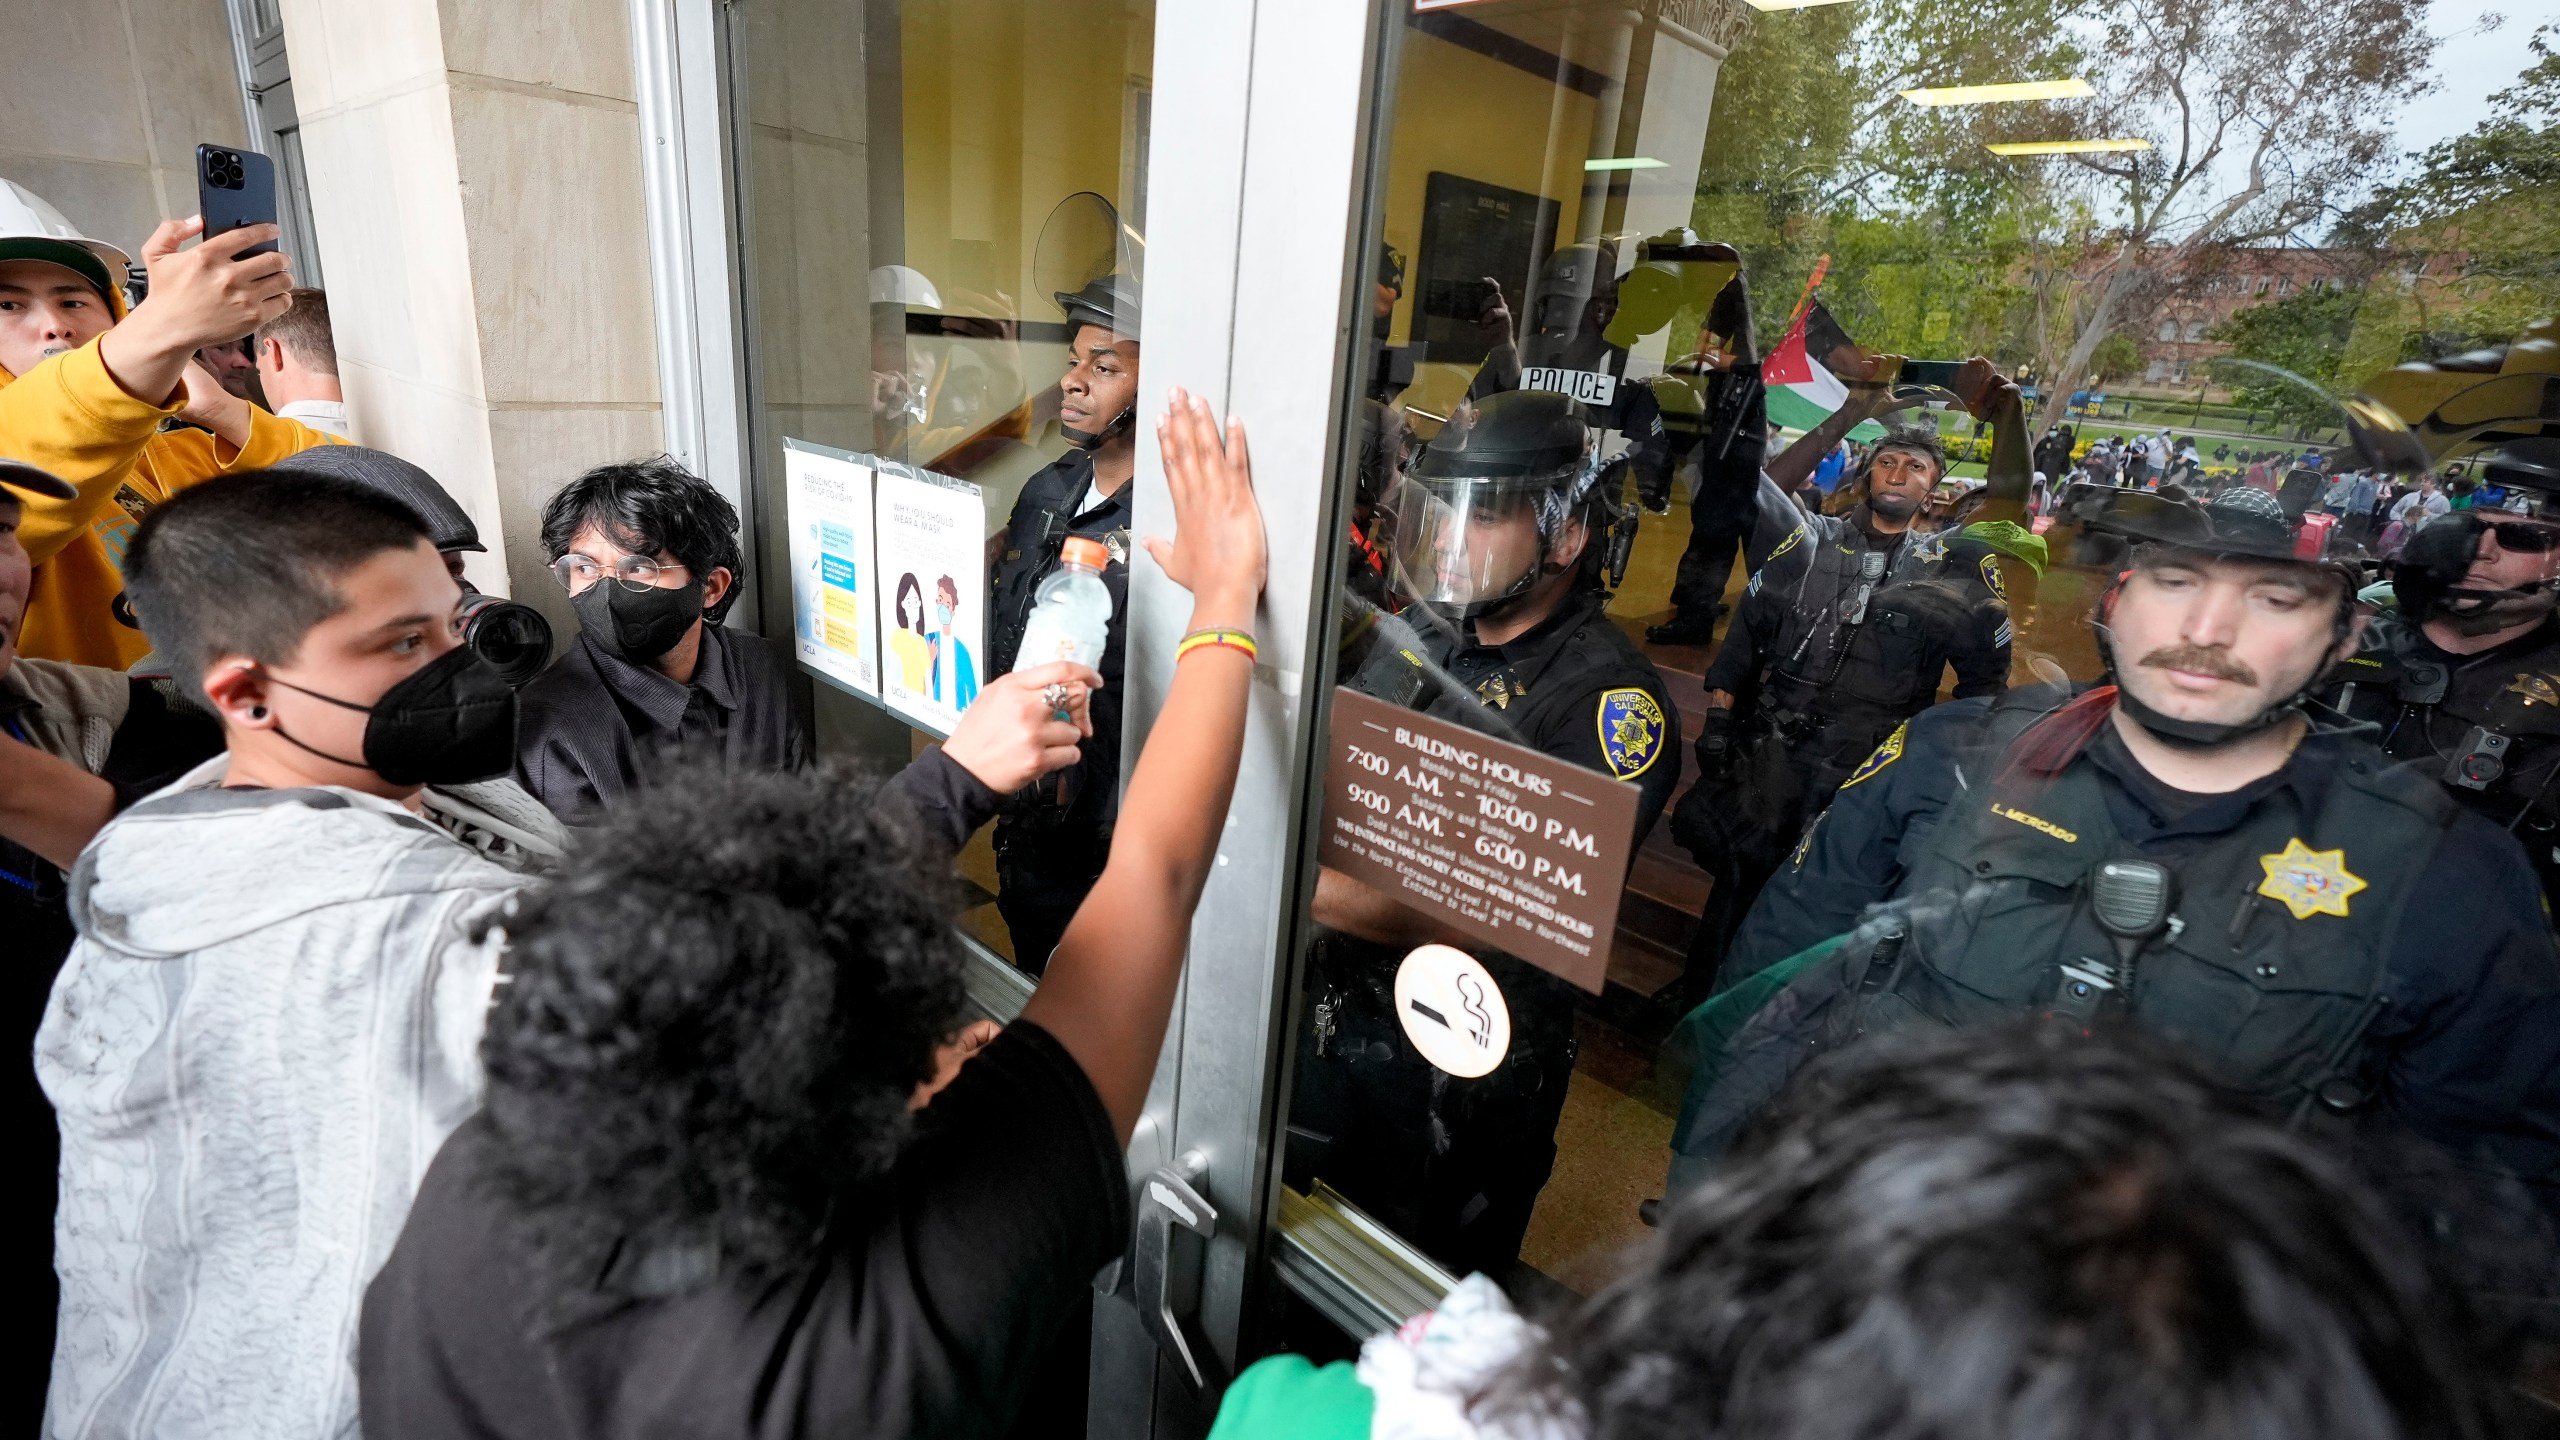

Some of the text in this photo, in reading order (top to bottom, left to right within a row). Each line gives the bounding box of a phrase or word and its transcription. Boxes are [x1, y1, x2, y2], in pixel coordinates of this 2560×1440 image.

[1528, 368, 1608, 400] POLICE
[803, 472, 844, 492] REDUCING THE
[893, 502, 909, 514] WHY
[926, 510, 953, 528] SHOULD
[893, 512, 940, 535] WEAR A MASK
[802, 642, 815, 656] UCLA
[891, 684, 906, 701] UCLA
[1609, 693, 1656, 713] UNIVERSITY
[1615, 702, 1658, 727] CALIFORNIA
[1394, 726, 1552, 798] BUILDING HOURS
[1611, 749, 1640, 769] POLICE
[1418, 755, 1456, 781] Monday
[1482, 779, 1518, 805] Friday
[1346, 743, 1390, 777] 7:00
[1394, 761, 1445, 799] A.M.
[1473, 791, 1538, 835] 10:00
[1543, 817, 1602, 859] P.M.
[1410, 791, 1516, 846] Saturday and Sunday
[1346, 780, 1391, 816] 9:00
[1394, 800, 1446, 838] A.M.
[1473, 832, 1527, 873] 6:00
[1532, 855, 1589, 898] P.M.
[1332, 832, 1349, 849] Use
[1351, 840, 1366, 857] the
[1368, 847, 1393, 869] North
[1395, 860, 1437, 889] Entrance
[1439, 880, 1451, 895] to
[1453, 886, 1481, 908] Level
[1493, 903, 1512, 922] and
[1515, 913, 1533, 931] the
[1335, 816, 1594, 939] THIS ENTRANCE HAS NO KEY ACCESS AFTER POSTED HOURS
[1390, 824, 1409, 841] Hall
[1423, 838, 1456, 862] Locked
[1458, 853, 1509, 886] University
[1512, 876, 1557, 906] Holidays
[1402, 875, 1444, 904] Entrance
[1446, 895, 1458, 910] to
[1460, 901, 1488, 923] Level
